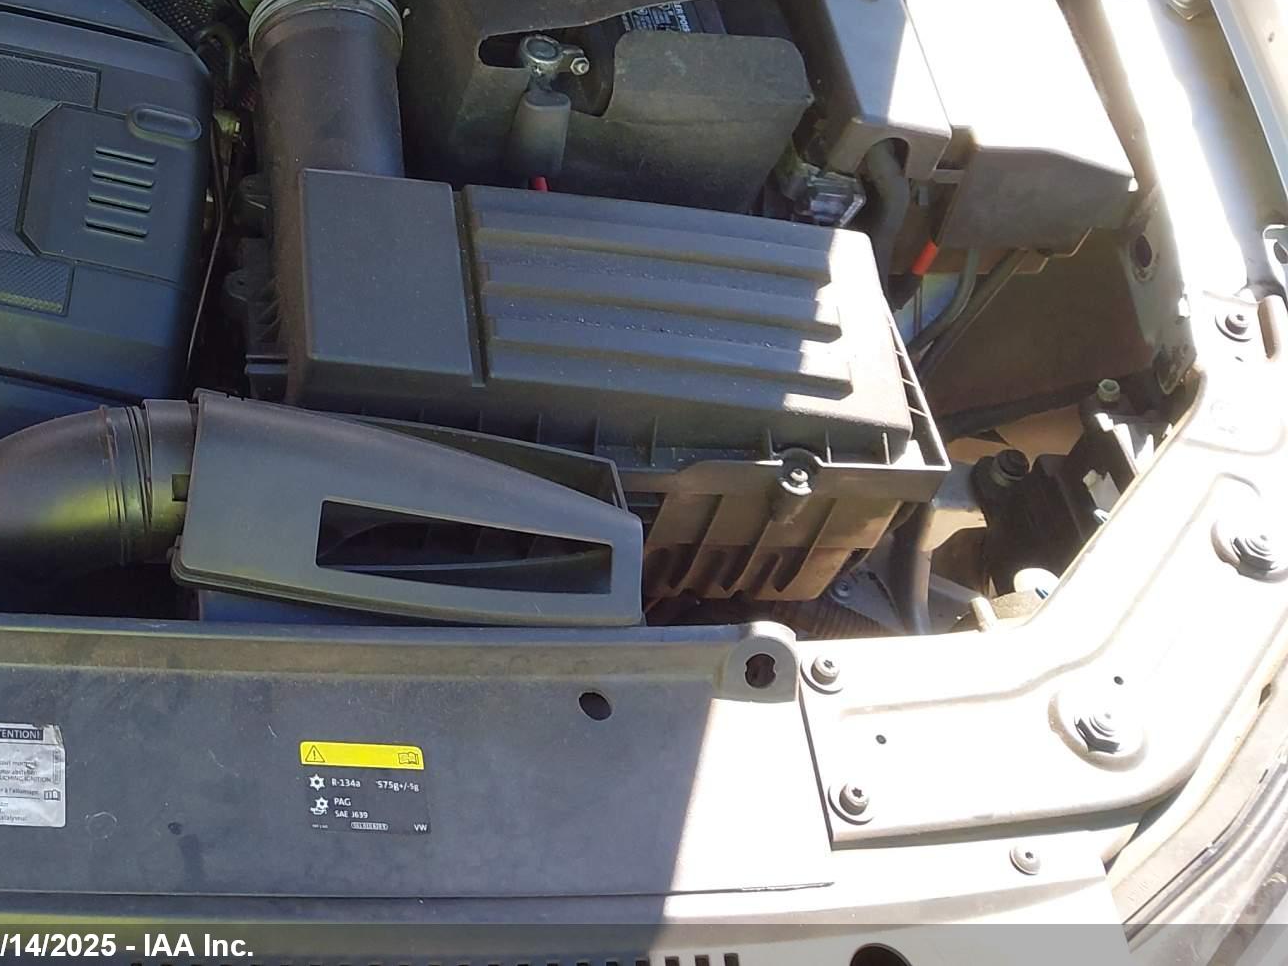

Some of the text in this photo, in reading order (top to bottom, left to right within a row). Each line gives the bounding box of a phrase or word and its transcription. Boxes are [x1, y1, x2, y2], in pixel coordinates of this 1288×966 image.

[332, 778, 361, 788] R-134a
[334, 798, 351, 806] PAG
[335, 810, 348, 818] SAE
[414, 824, 428, 832] VW
